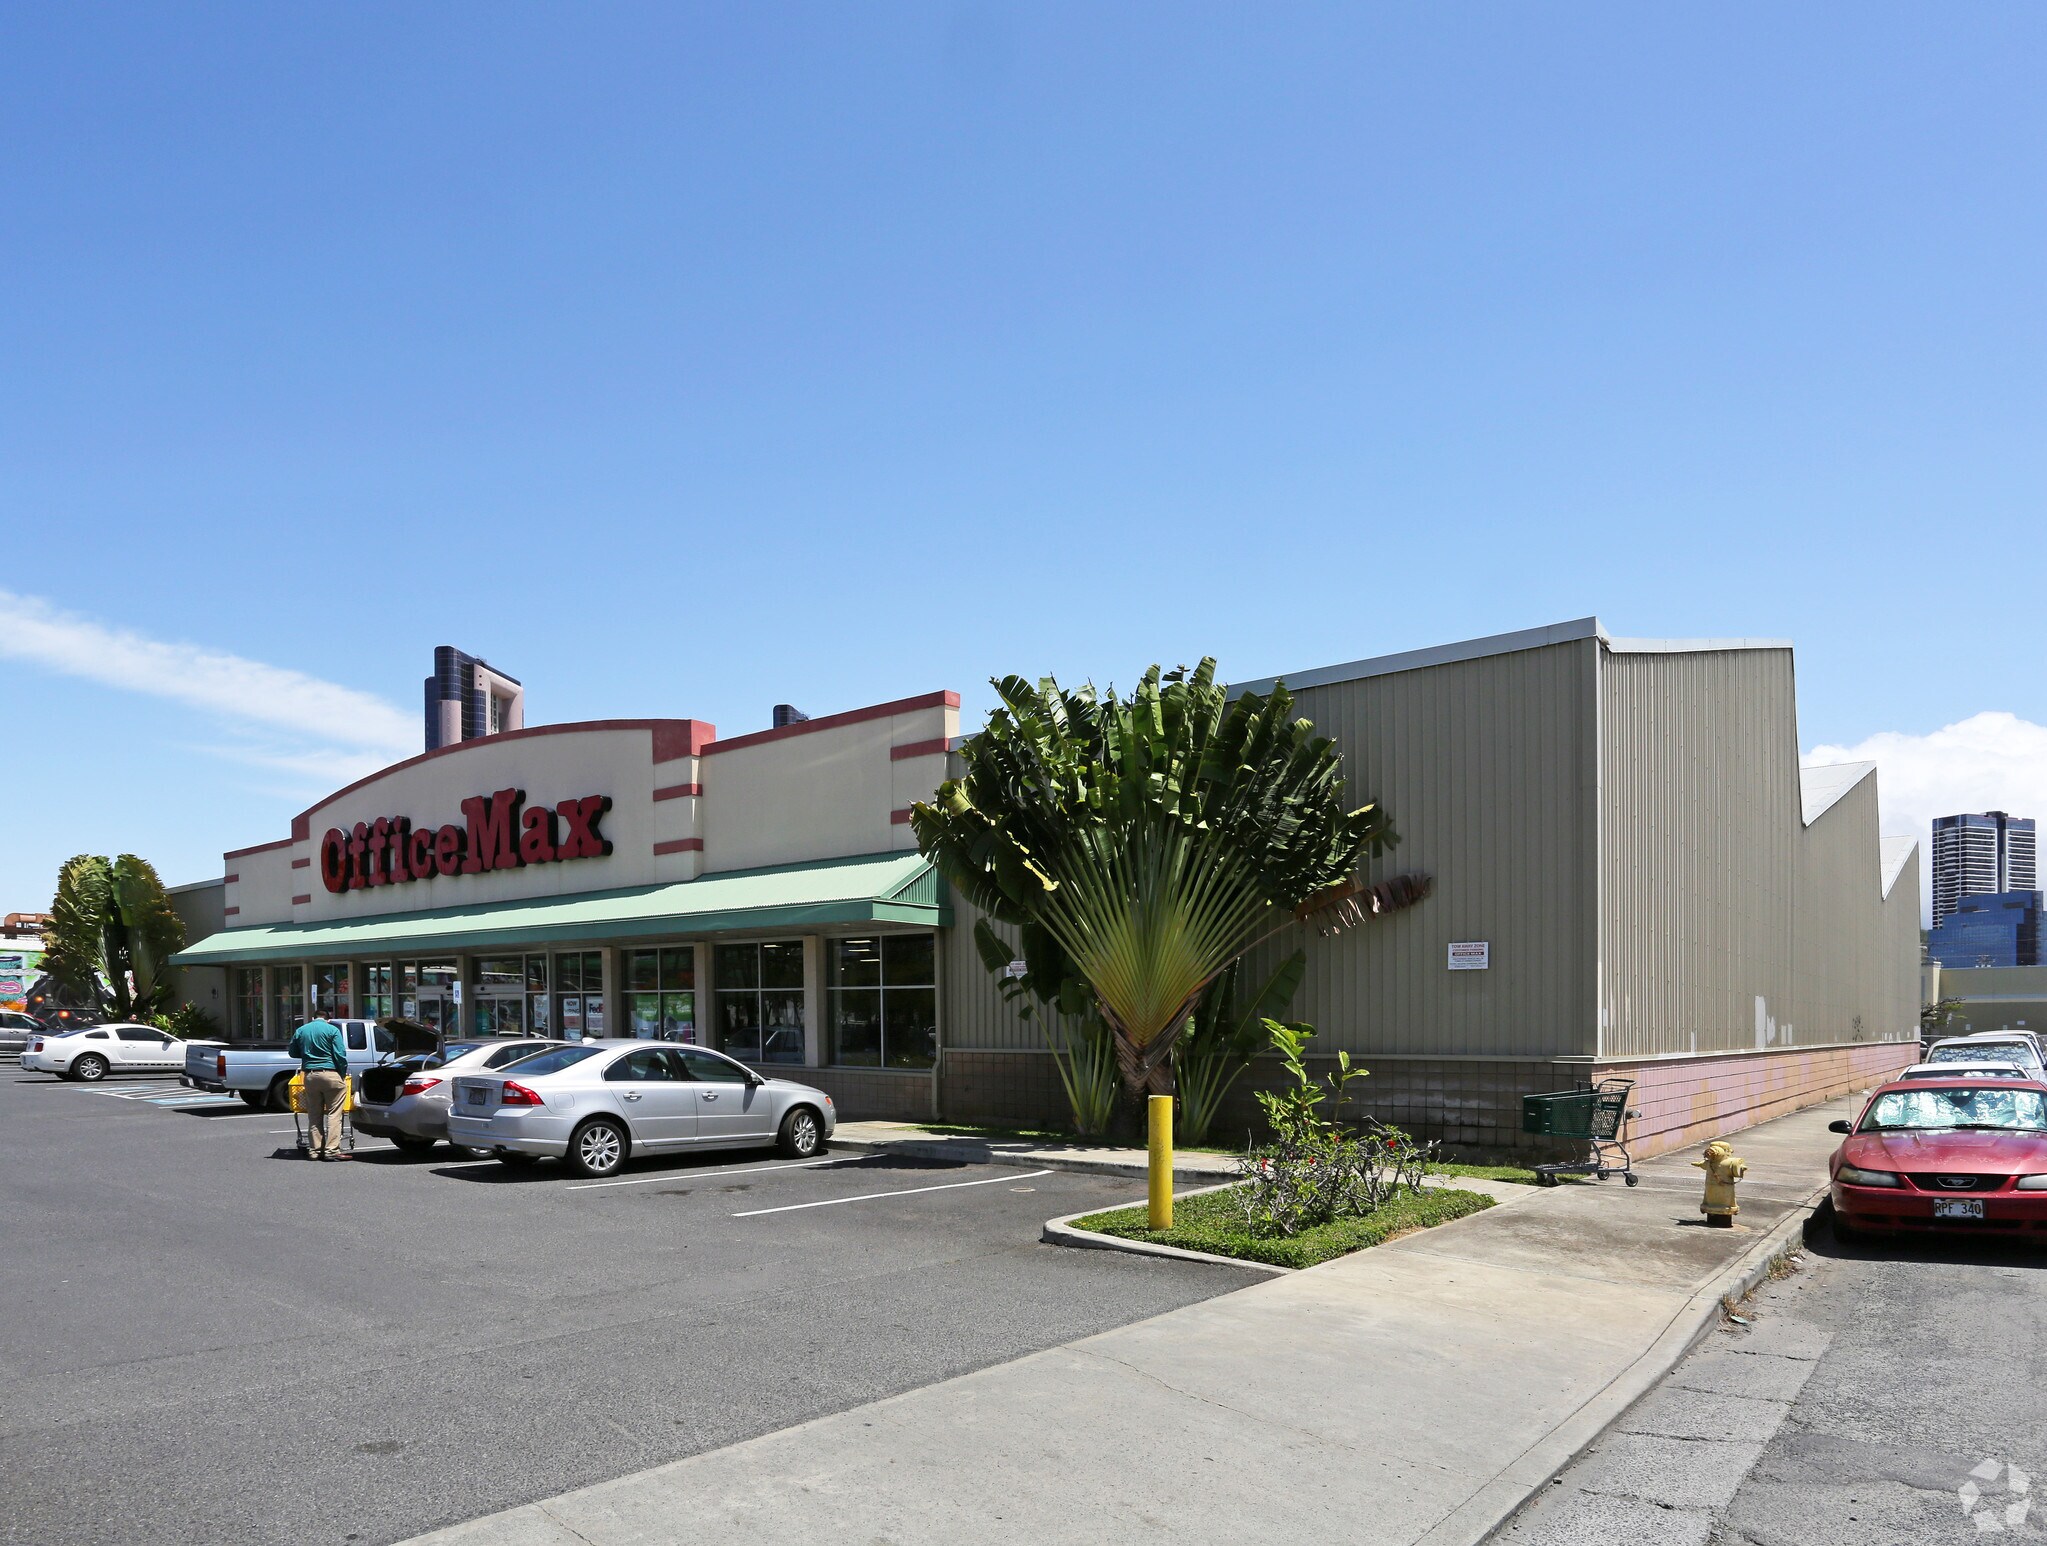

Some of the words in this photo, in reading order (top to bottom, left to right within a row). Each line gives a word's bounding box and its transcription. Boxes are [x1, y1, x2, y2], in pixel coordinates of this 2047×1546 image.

[321, 787, 613, 893] OfficeMax
[589, 1003, 604, 1013] FedE
[1935, 1202, 1954, 1214] RPF
[1961, 1203, 1982, 1215] 340
